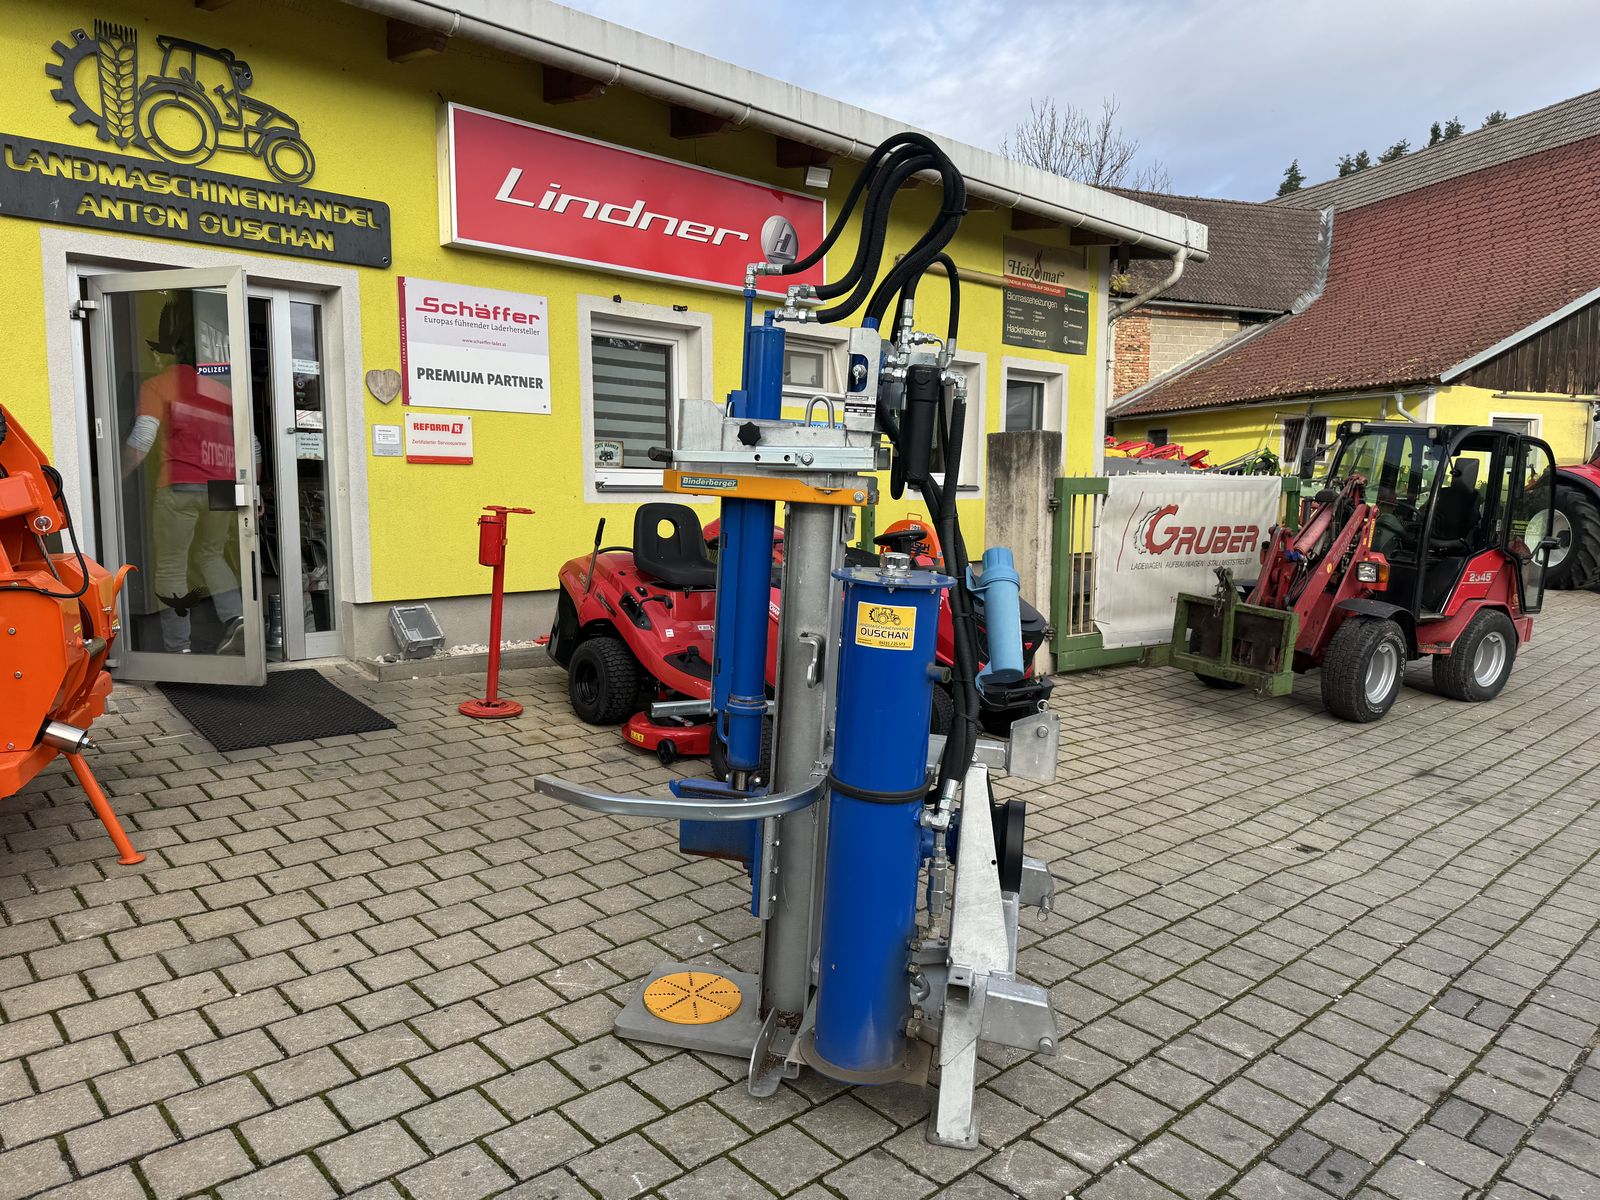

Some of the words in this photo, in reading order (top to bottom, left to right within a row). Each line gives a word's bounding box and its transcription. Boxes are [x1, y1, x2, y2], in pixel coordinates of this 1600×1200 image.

[4, 143, 381, 230] LANDMASCHINENHANDEL
[495, 167, 749, 246] Lindner
[76, 192, 190, 231] ANTON
[199, 211, 335, 253] OUSCHAN
[1006, 291, 1058, 309] Biomasseheizungen
[415, 296, 540, 325] Schäffer
[423, 315, 453, 327] Europas
[454, 318, 490, 331] führender
[490, 323, 540, 336] Laderhersteller
[1006, 324, 1047, 338] Hackmaschinen
[416, 367, 484, 385] PREMIUM
[487, 373, 543, 390] PARTNER
[413, 422, 450, 433] REFORM
[682, 475, 738, 488] Binderberger
[1145, 503, 1260, 556] GRUBER
[1130, 561, 1163, 571] LADEWAGEN
[1165, 559, 1204, 569] AUFBAUWAGEN
[1468, 572, 1493, 582] 2345
[860, 627, 909, 640] OUSCHAN
